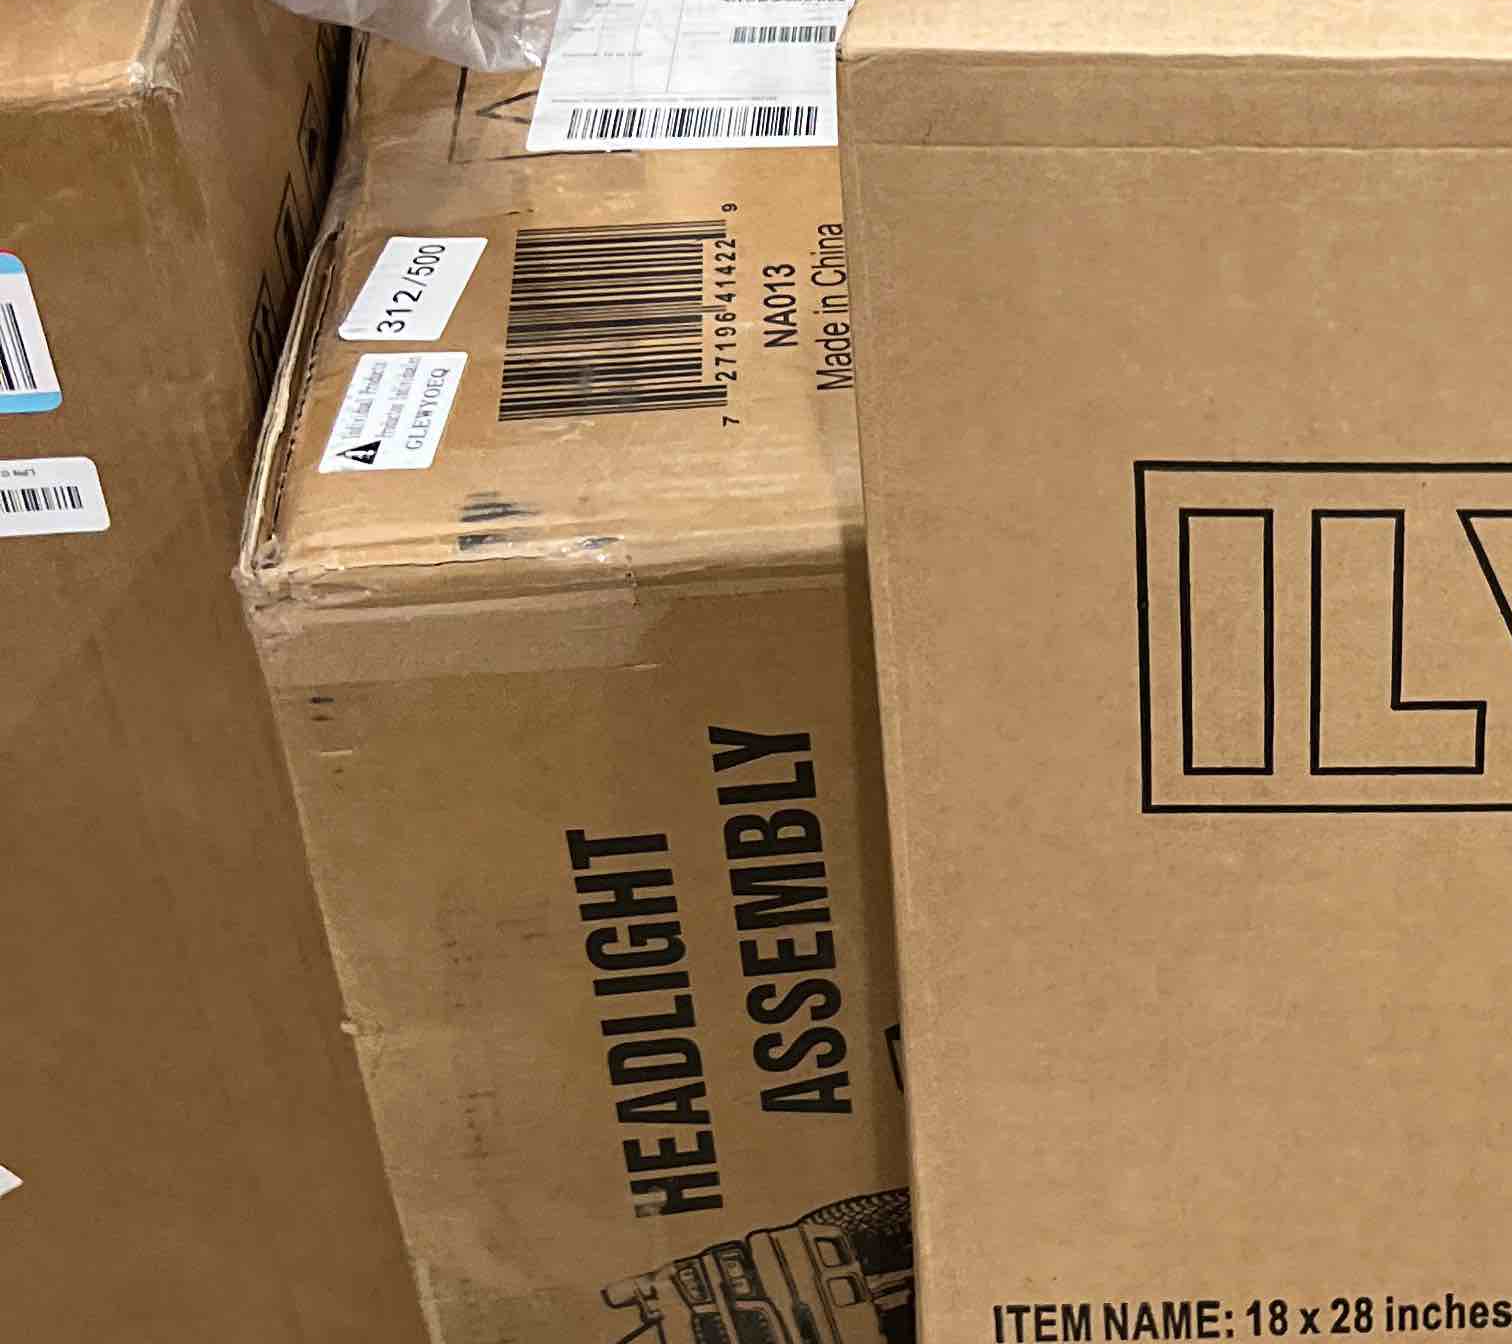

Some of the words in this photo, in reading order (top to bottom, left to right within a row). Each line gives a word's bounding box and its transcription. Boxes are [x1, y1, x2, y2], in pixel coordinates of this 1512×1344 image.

[721, 203, 738, 213] 9
[716, 239, 737, 304] 41422
[811, 222, 846, 287] China
[762, 263, 799, 348] NA013
[813, 295, 848, 317] in
[715, 312, 738, 382] 27196
[816, 319, 855, 392] Made
[722, 415, 740, 427] 7
[708, 724, 852, 1115] ASSEMBLY
[566, 828, 723, 1219] HEADLIGHT
[993, 1303, 1092, 1344] ITEM
[1103, 1300, 1234, 1341] NAME:
[1245, 1299, 1288, 1337] 18
[1299, 1307, 1321, 1335] x
[1330, 1296, 1373, 1334] 28
[1385, 1292, 1512, 1332] inches
